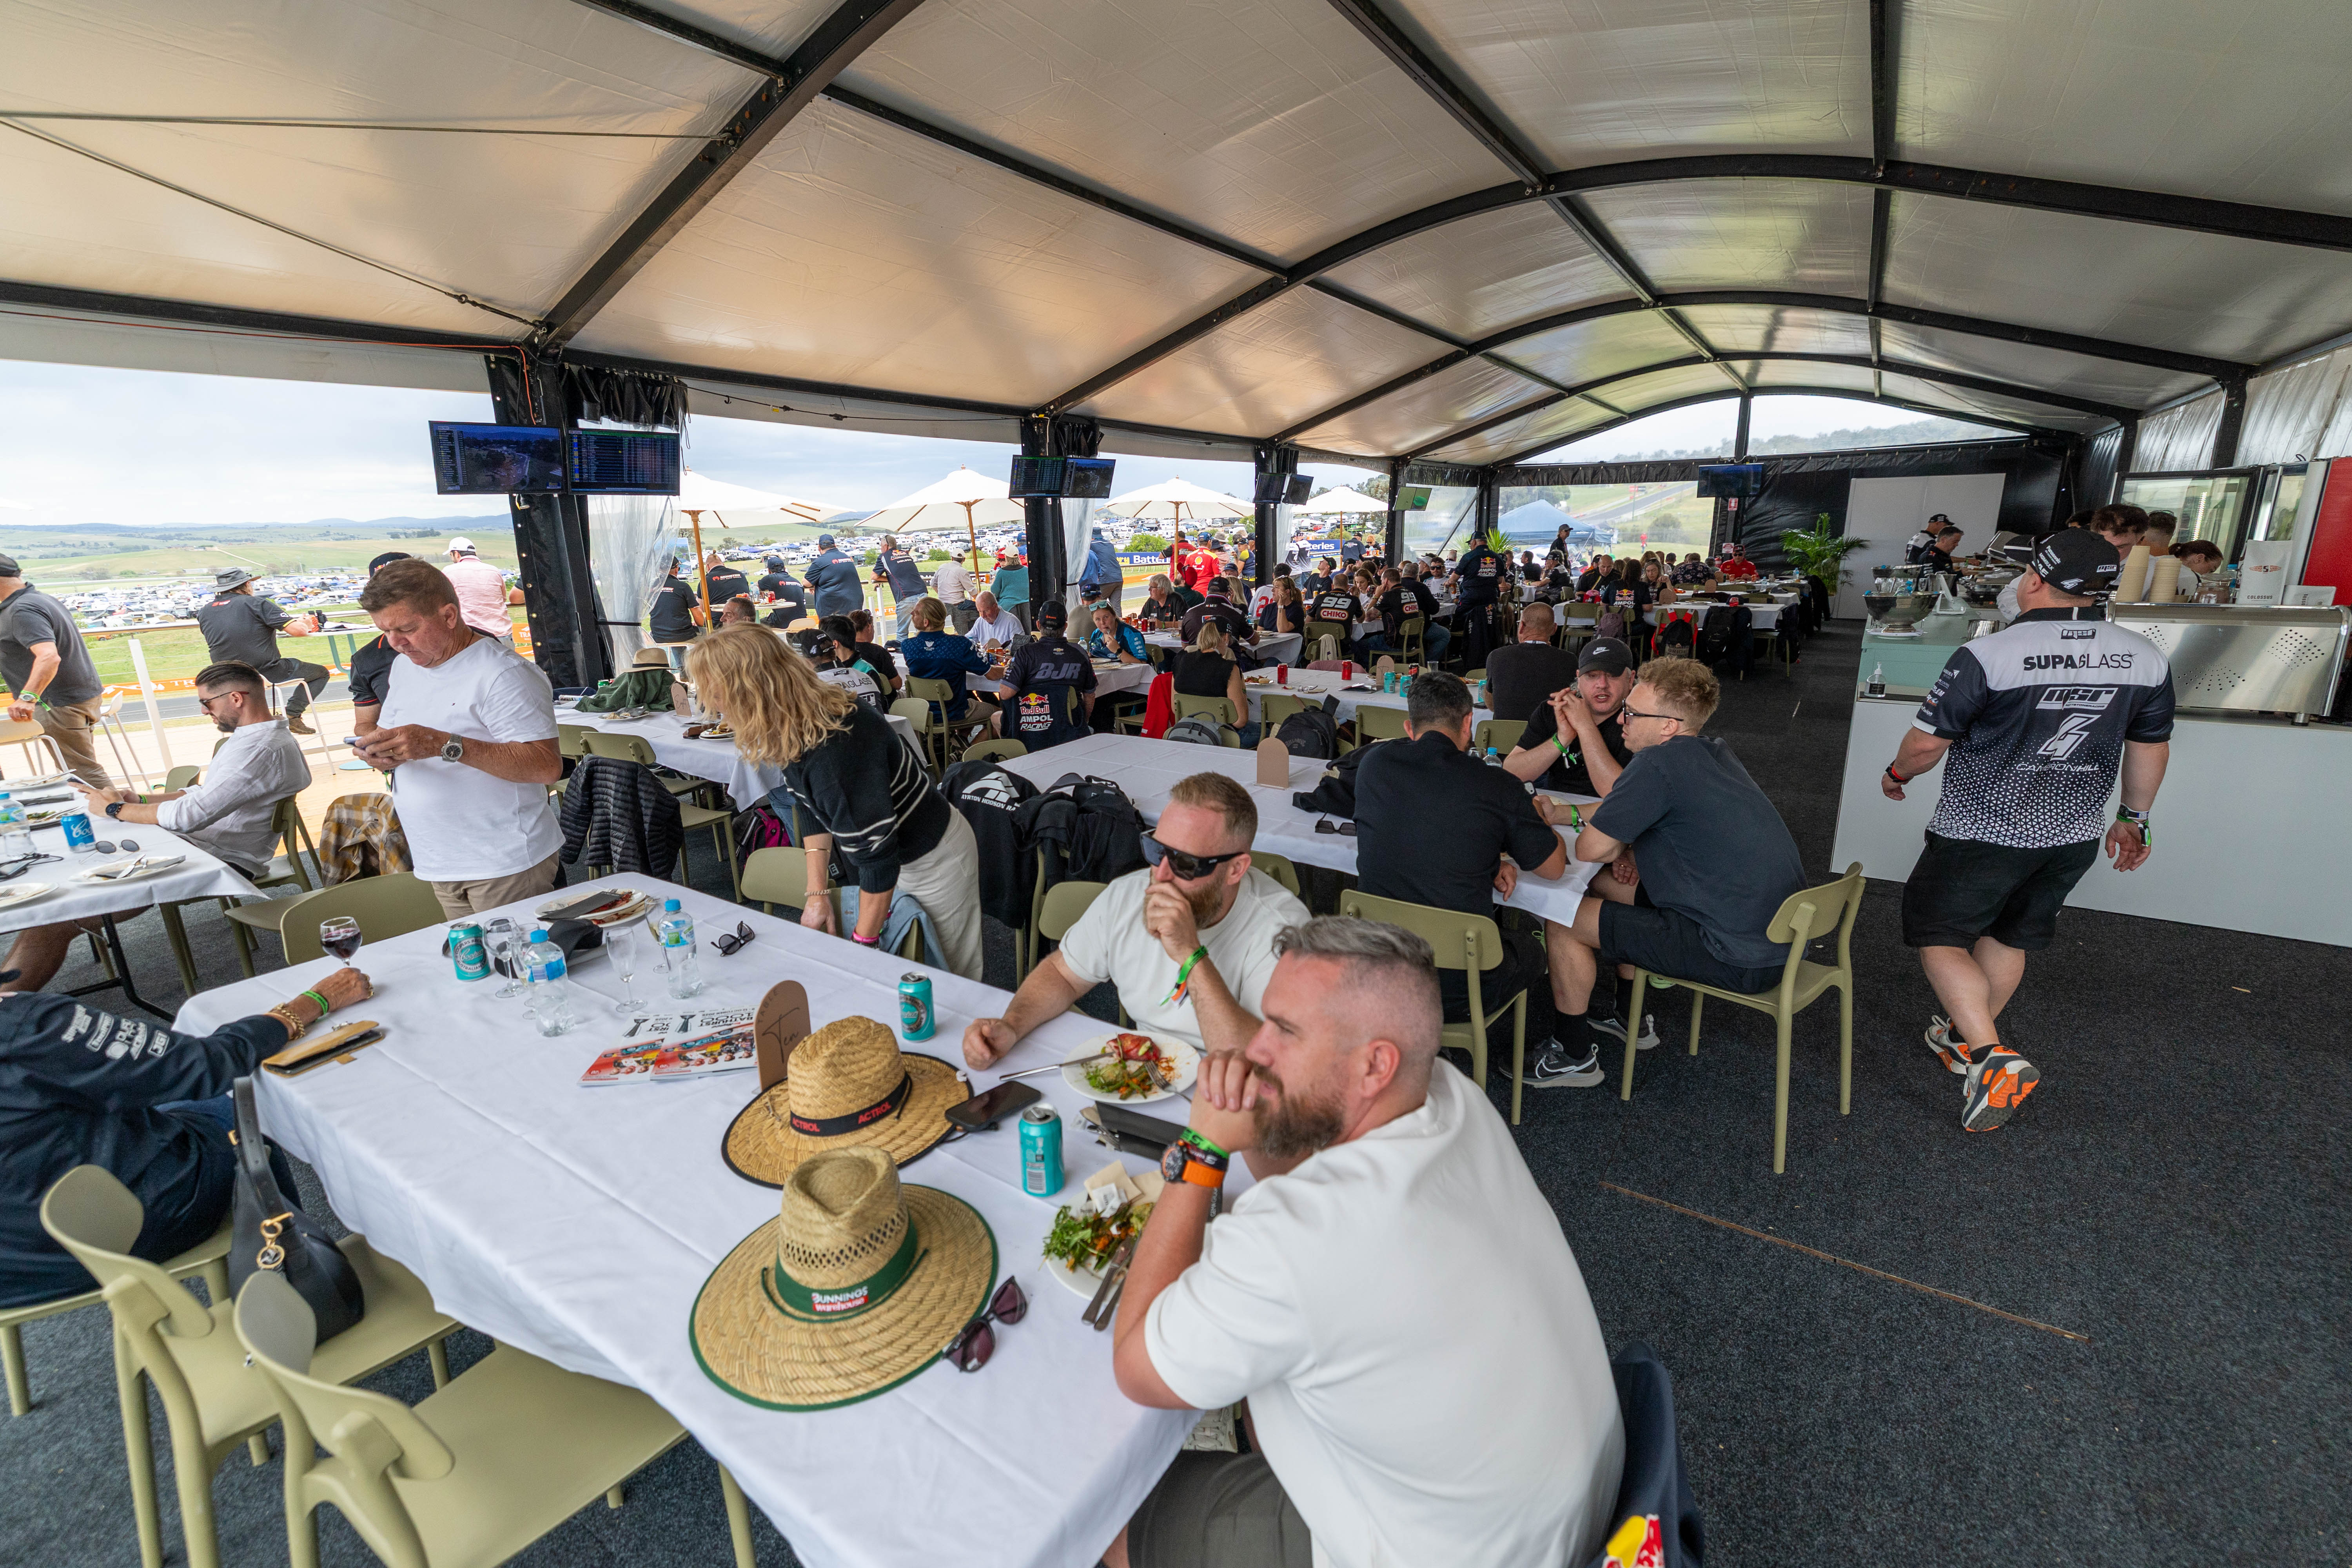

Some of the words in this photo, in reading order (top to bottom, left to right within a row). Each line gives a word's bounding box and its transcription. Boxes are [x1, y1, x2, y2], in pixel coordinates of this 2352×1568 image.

[2046, 545, 2060, 564] Panasonic
[2060, 578, 2084, 589] 4
[1321, 597, 1352, 608] 99
[1401, 592, 1417, 603] 99
[1322, 610, 1347, 619] CHIKO
[1035, 662, 1081, 679] BJR
[1020, 706, 1033, 715] Red
[1034, 705, 1050, 714] Bull
[1020, 715, 1053, 723] AMPOL
[2037, 713, 2101, 761] 4
[961, 794, 981, 802] AYRTON
[982, 798, 1006, 809] HODSON
[757, 988, 779, 1024] TABLE
[699, 1016, 753, 1027] BATHURST
[701, 1013, 754, 1022] 1000
[762, 1007, 800, 1063] Ten
[858, 1102, 892, 1124] ACTROL
[792, 1117, 820, 1132] ACTROL
[811, 1286, 868, 1303] BUNNINGS
